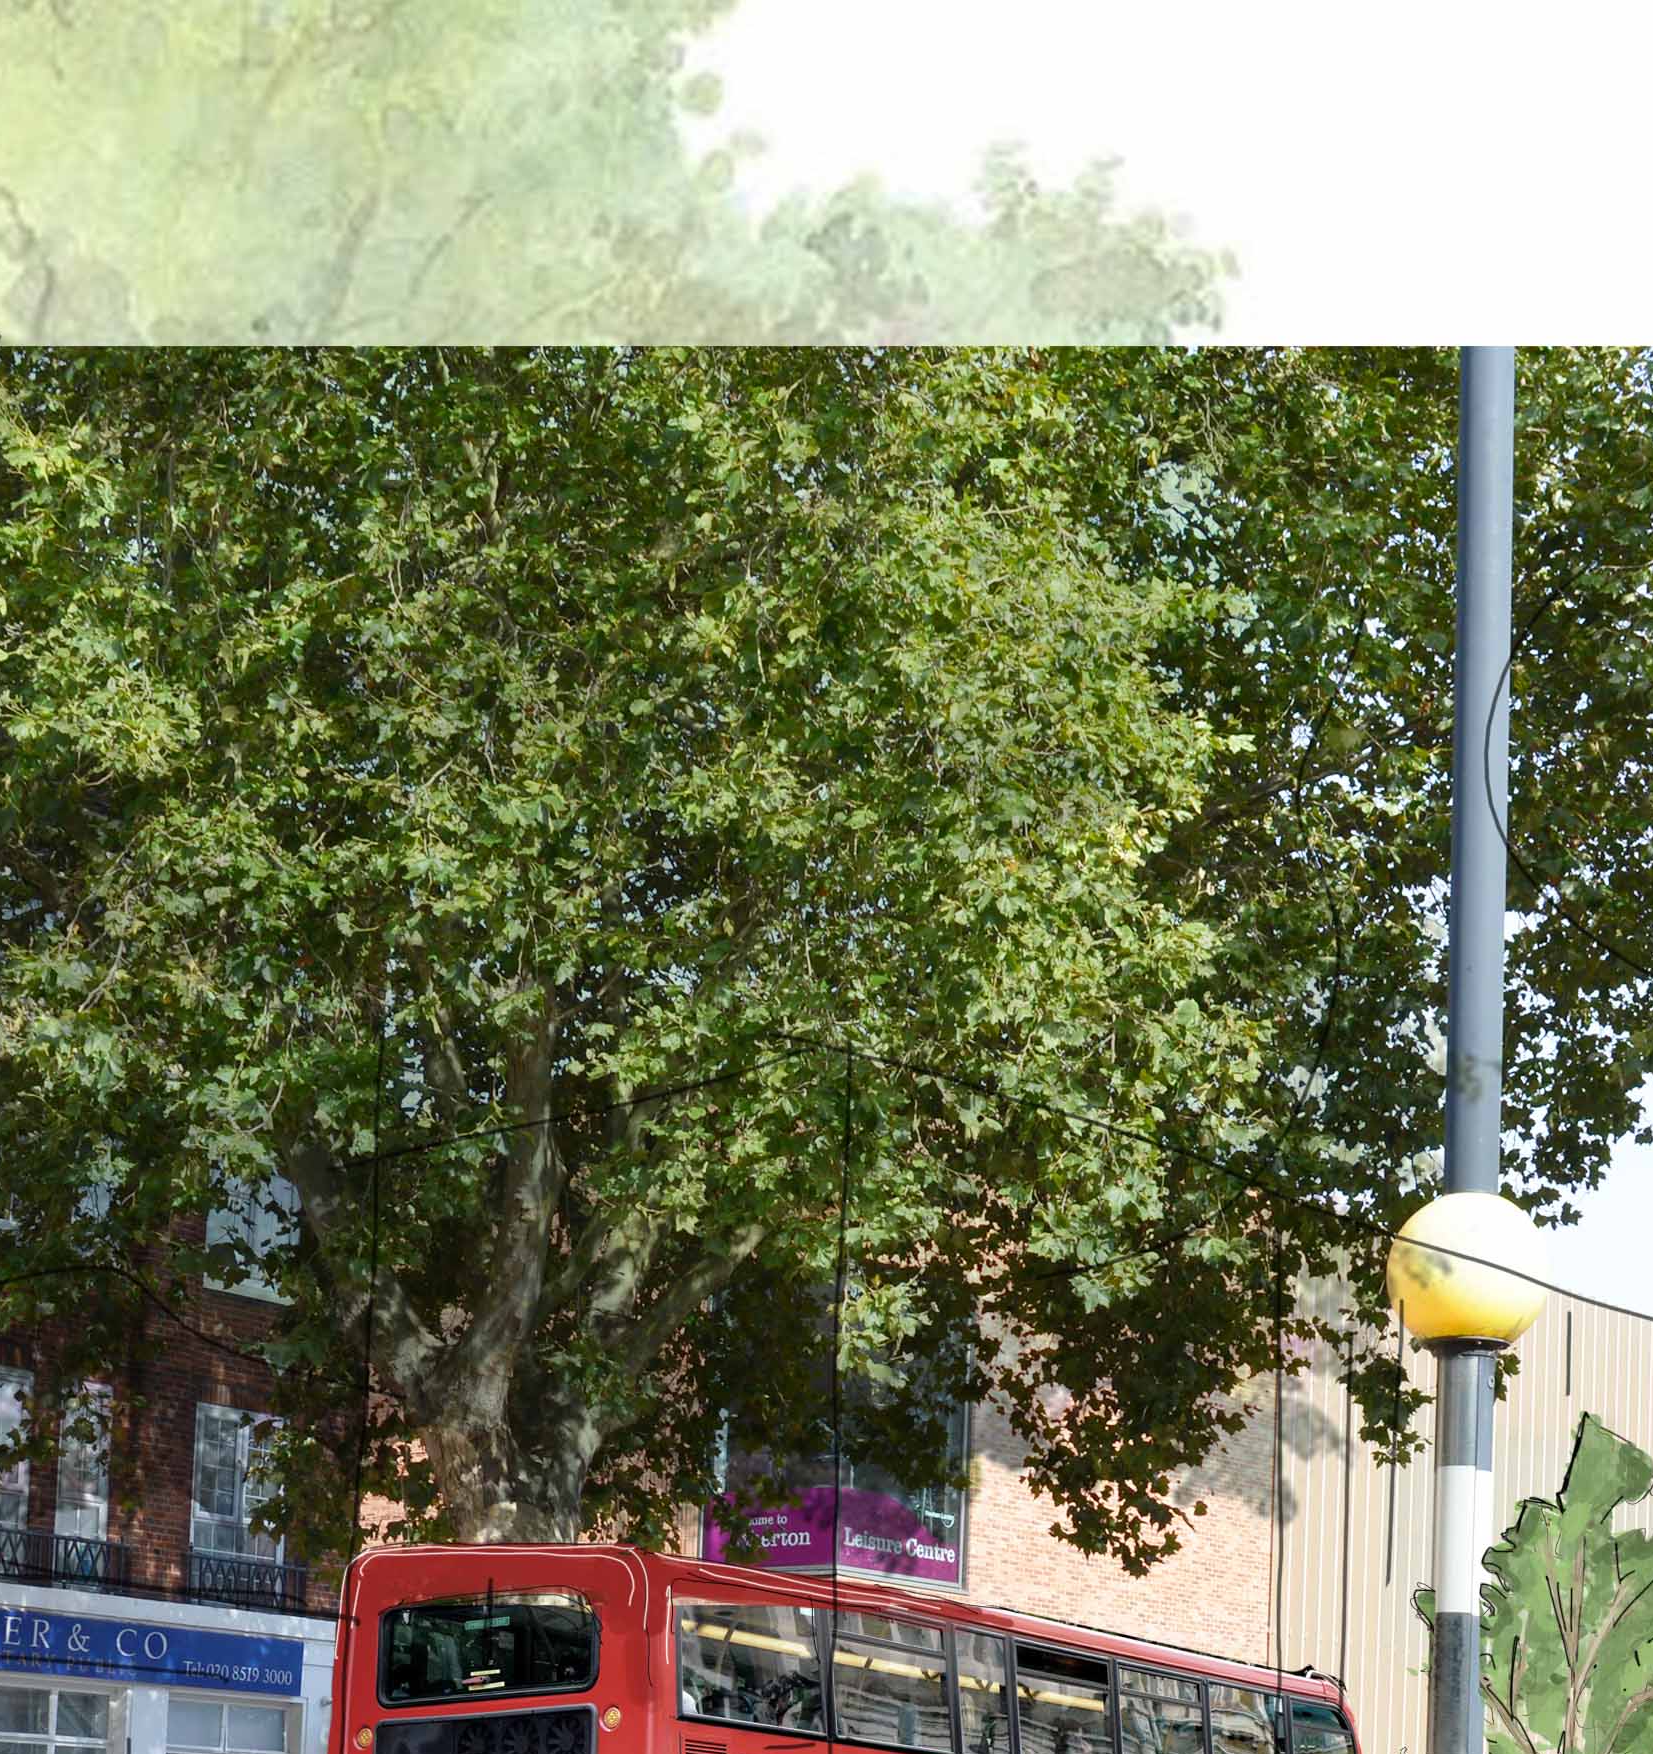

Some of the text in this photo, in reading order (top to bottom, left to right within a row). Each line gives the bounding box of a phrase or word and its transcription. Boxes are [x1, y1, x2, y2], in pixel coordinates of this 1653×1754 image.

[844, 1526, 955, 1563] Leisure Centre
[67, 1623, 90, 1652] &
[116, 1628, 169, 1660] CO
[232, 1665, 260, 1682] 8519
[263, 1670, 292, 1685] 3000
